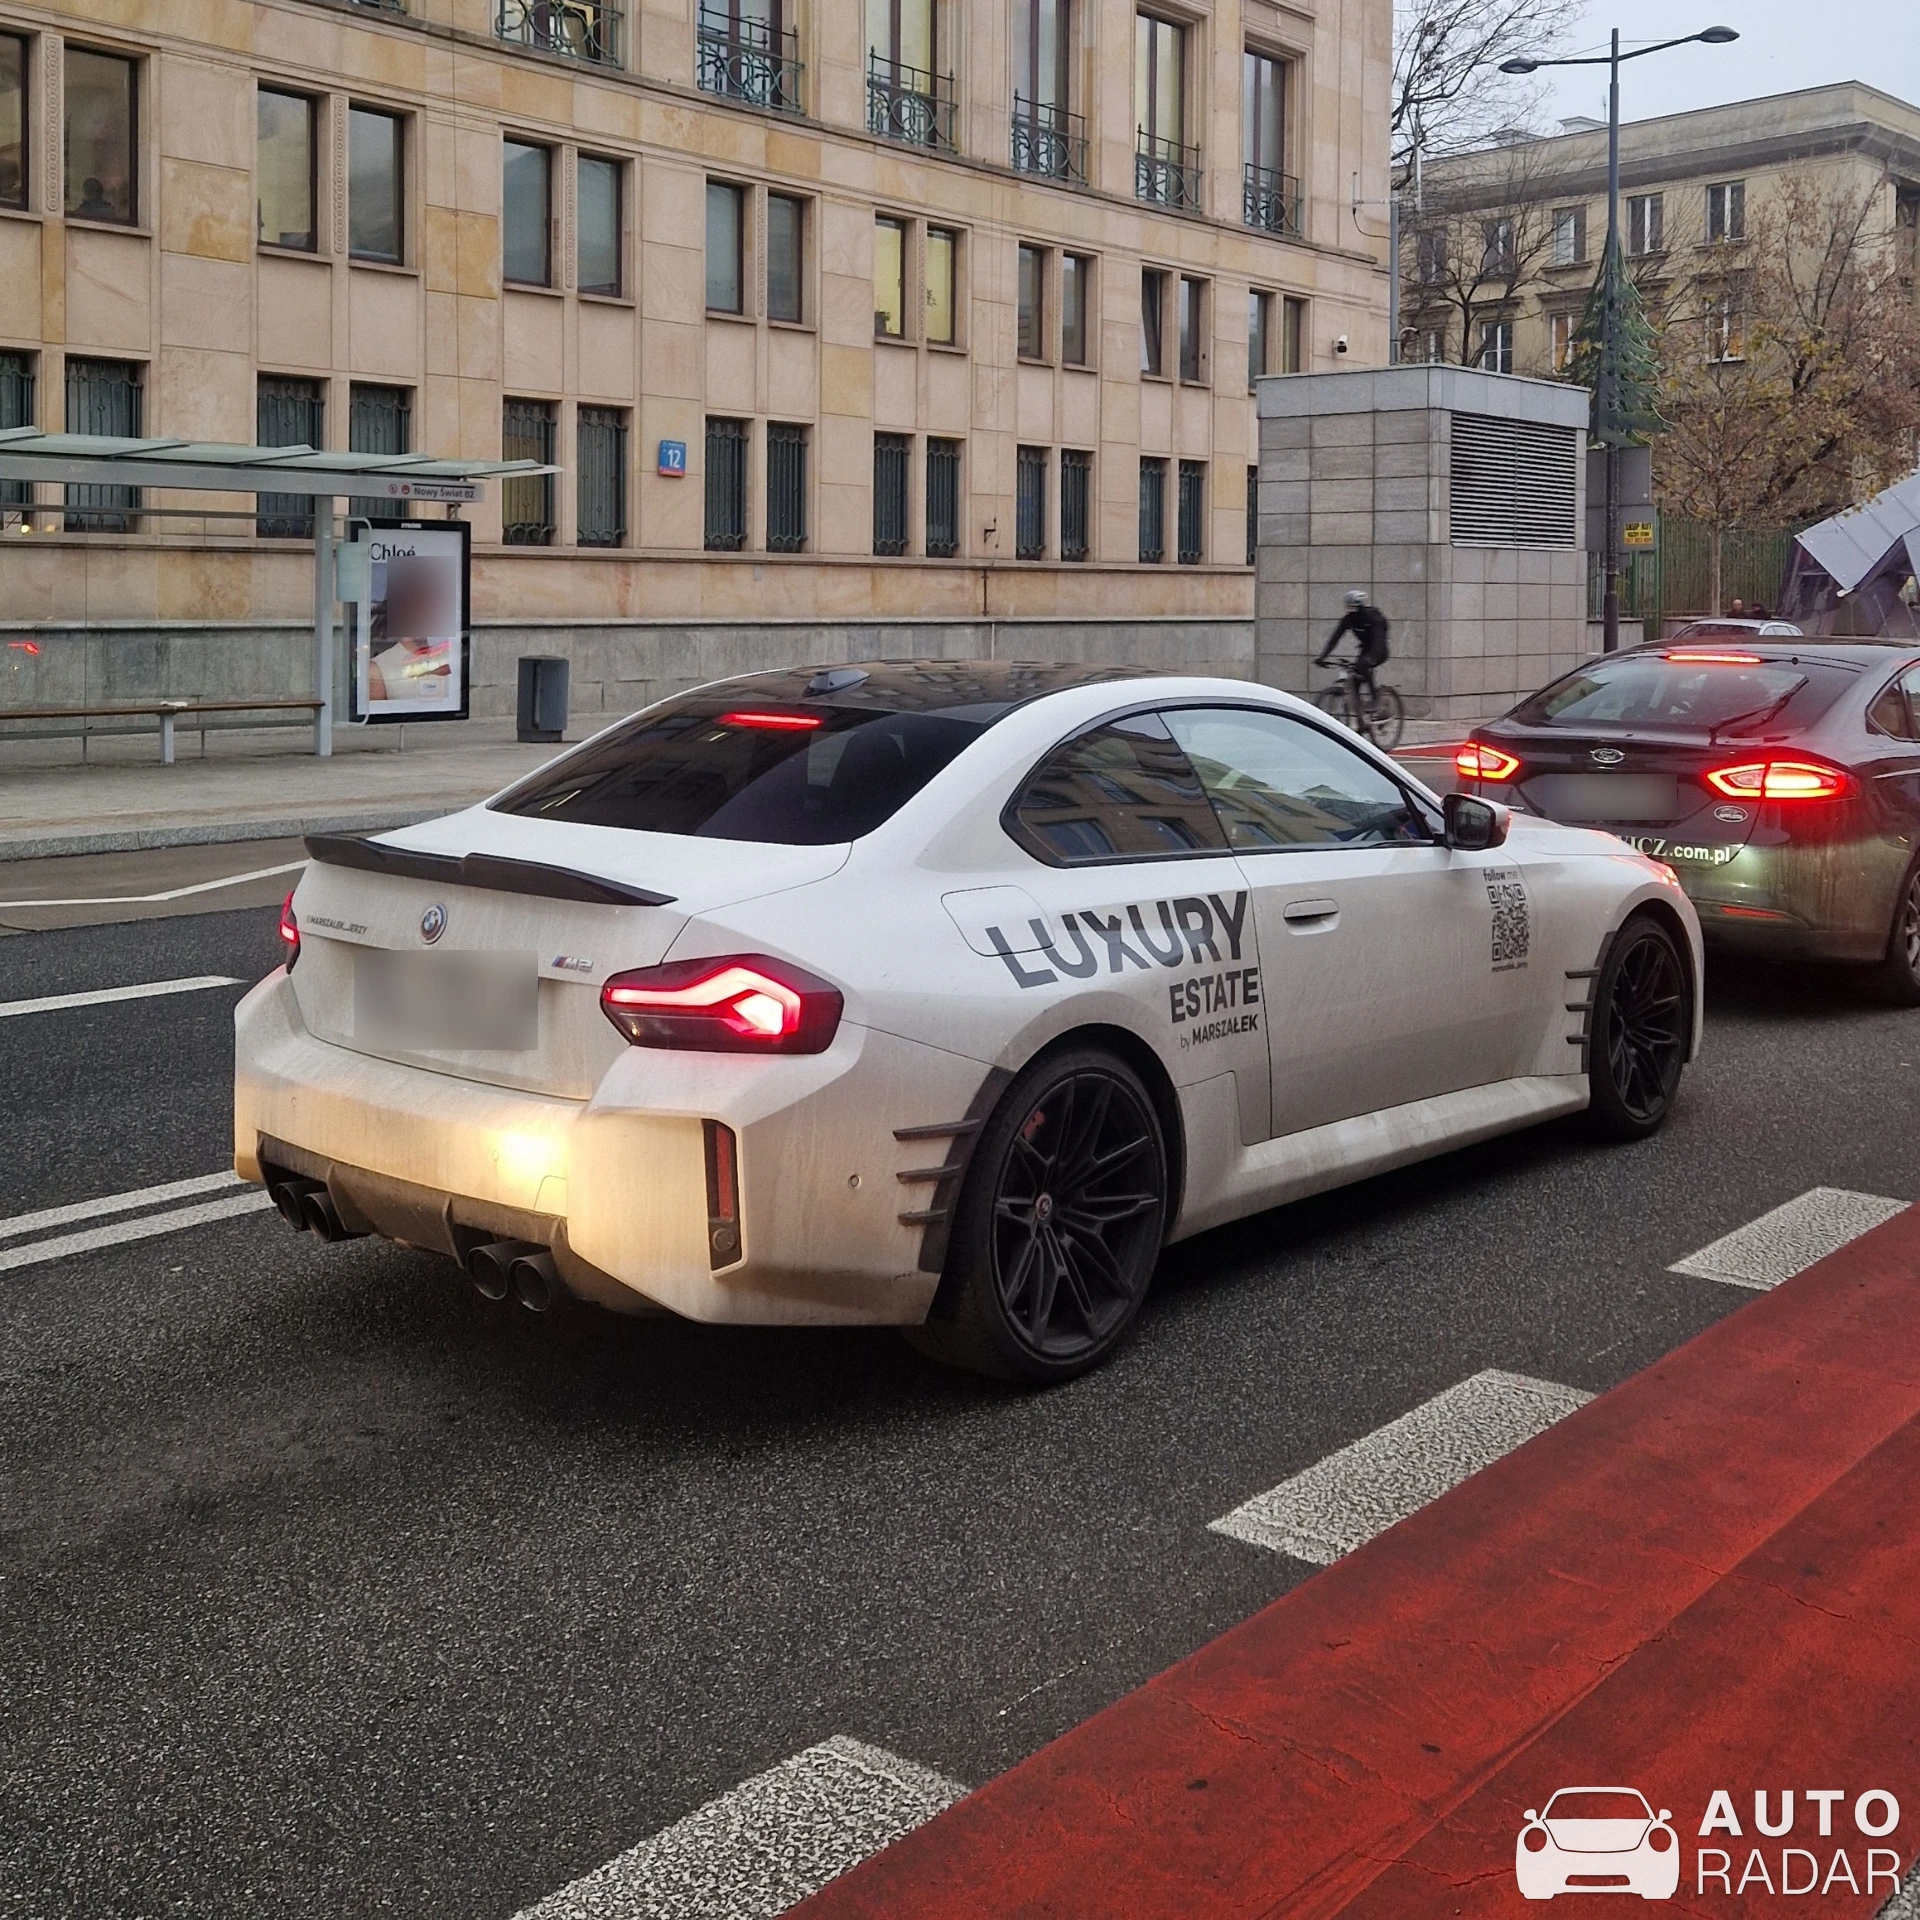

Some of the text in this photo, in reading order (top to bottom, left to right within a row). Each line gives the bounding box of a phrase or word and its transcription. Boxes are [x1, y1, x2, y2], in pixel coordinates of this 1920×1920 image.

[668, 449, 681, 468] 12
[414, 487, 475, 499] Nowy Świat 02
[1483, 868, 1506, 882] follow
[985, 890, 1249, 990] LUXURY
[1169, 966, 1261, 1024] ESTATE
[1180, 1013, 1259, 1052] by MARSZAŁEK
